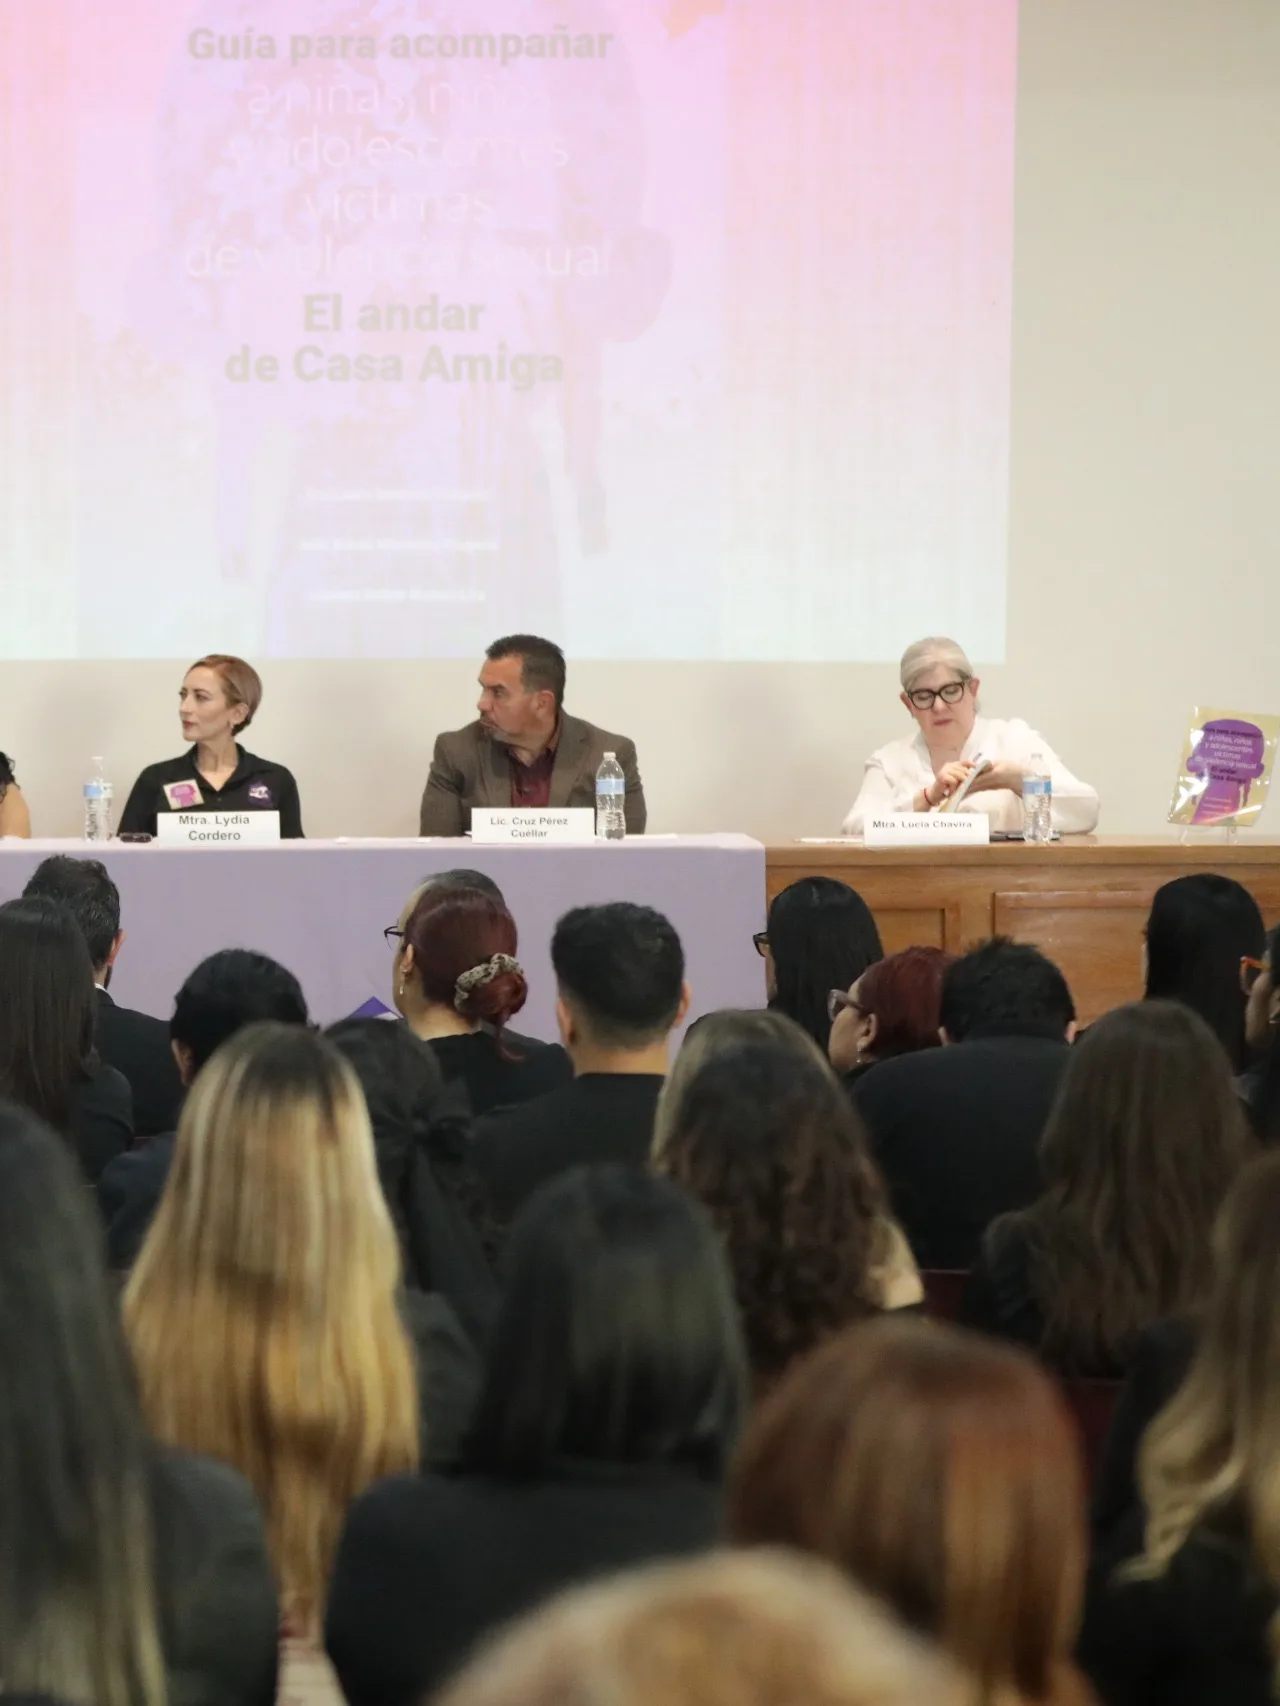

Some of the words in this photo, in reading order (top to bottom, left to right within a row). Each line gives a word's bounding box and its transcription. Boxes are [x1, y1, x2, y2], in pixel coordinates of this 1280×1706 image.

[187, 27, 277, 60] Guía
[289, 33, 379, 66] para
[390, 26, 614, 66] acompañar
[303, 293, 342, 332] El
[358, 293, 487, 333] andar
[225, 345, 280, 383] de
[293, 345, 404, 383] Casa
[419, 343, 565, 391] Amiga
[179, 815, 211, 825] Mtra.
[215, 814, 250, 828] Lydia
[512, 816, 536, 826] Cruz
[188, 830, 241, 841] Cordero
